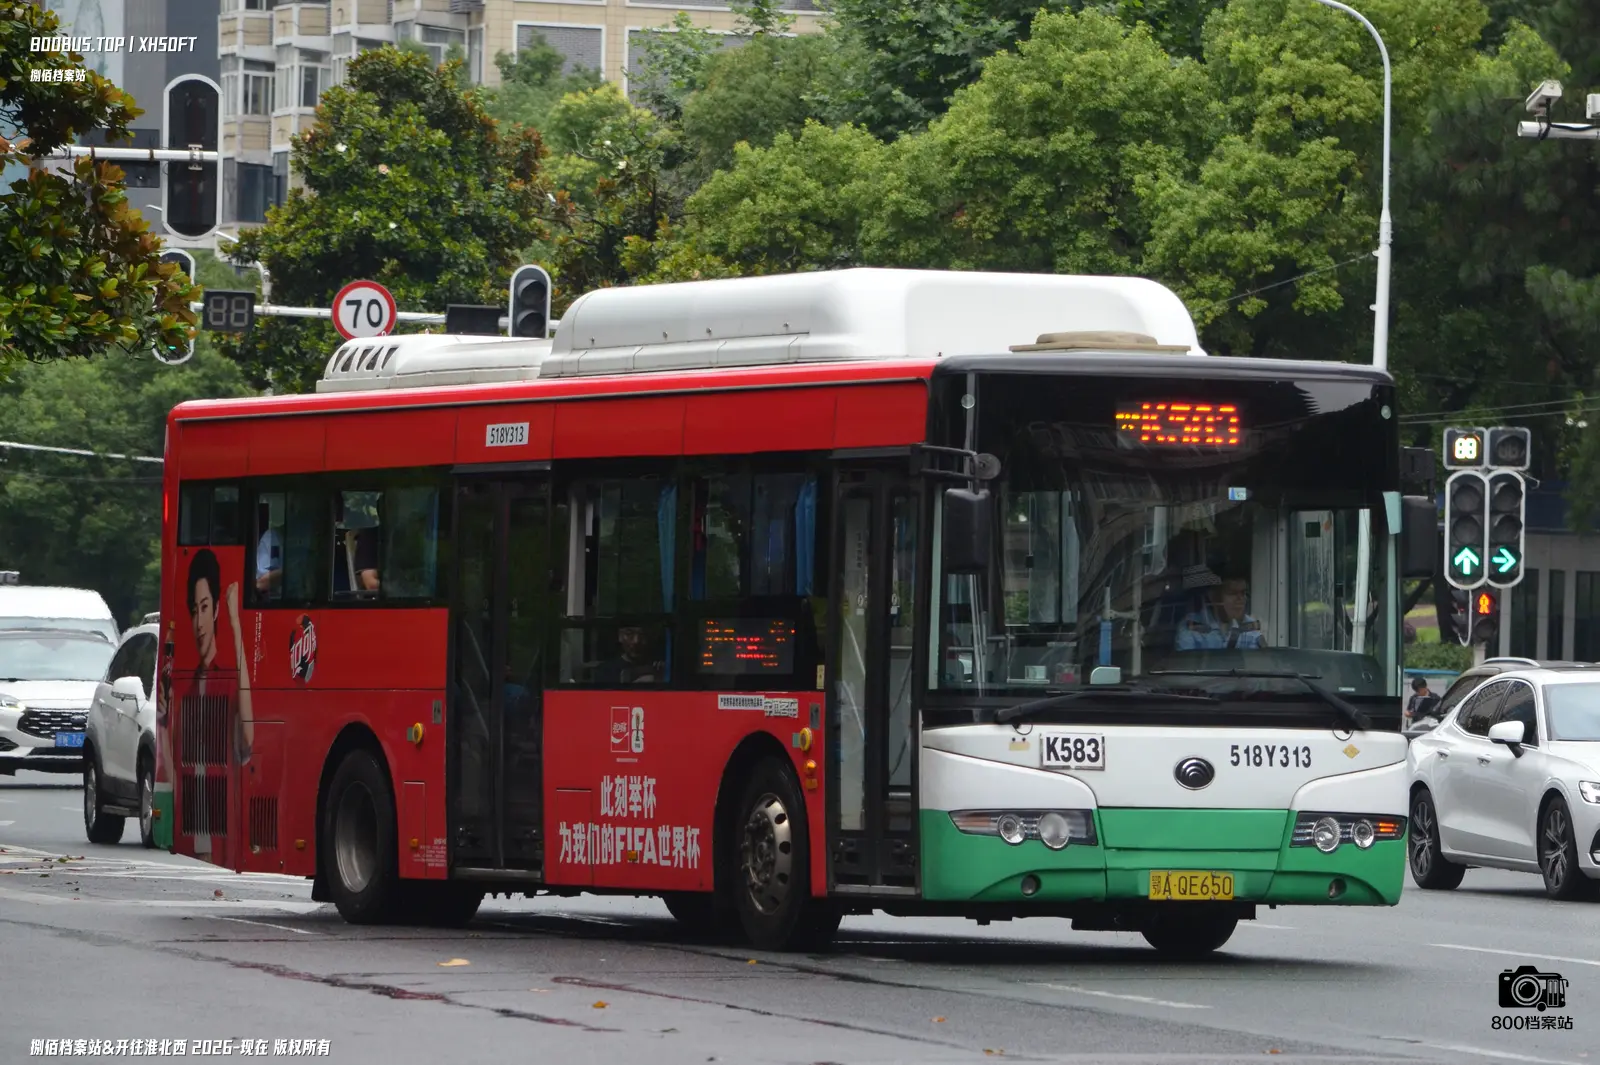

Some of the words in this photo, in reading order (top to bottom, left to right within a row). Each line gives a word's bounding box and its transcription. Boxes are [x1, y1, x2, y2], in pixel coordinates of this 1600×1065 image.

[346, 299, 383, 329] 70
[490, 425, 524, 444] 518Y313
[1046, 736, 1100, 763] K583
[1230, 744, 1312, 768] 518Y313
[600, 775, 657, 819] 此刻举杯
[559, 821, 701, 869] 为我们的FIFA世界杯
